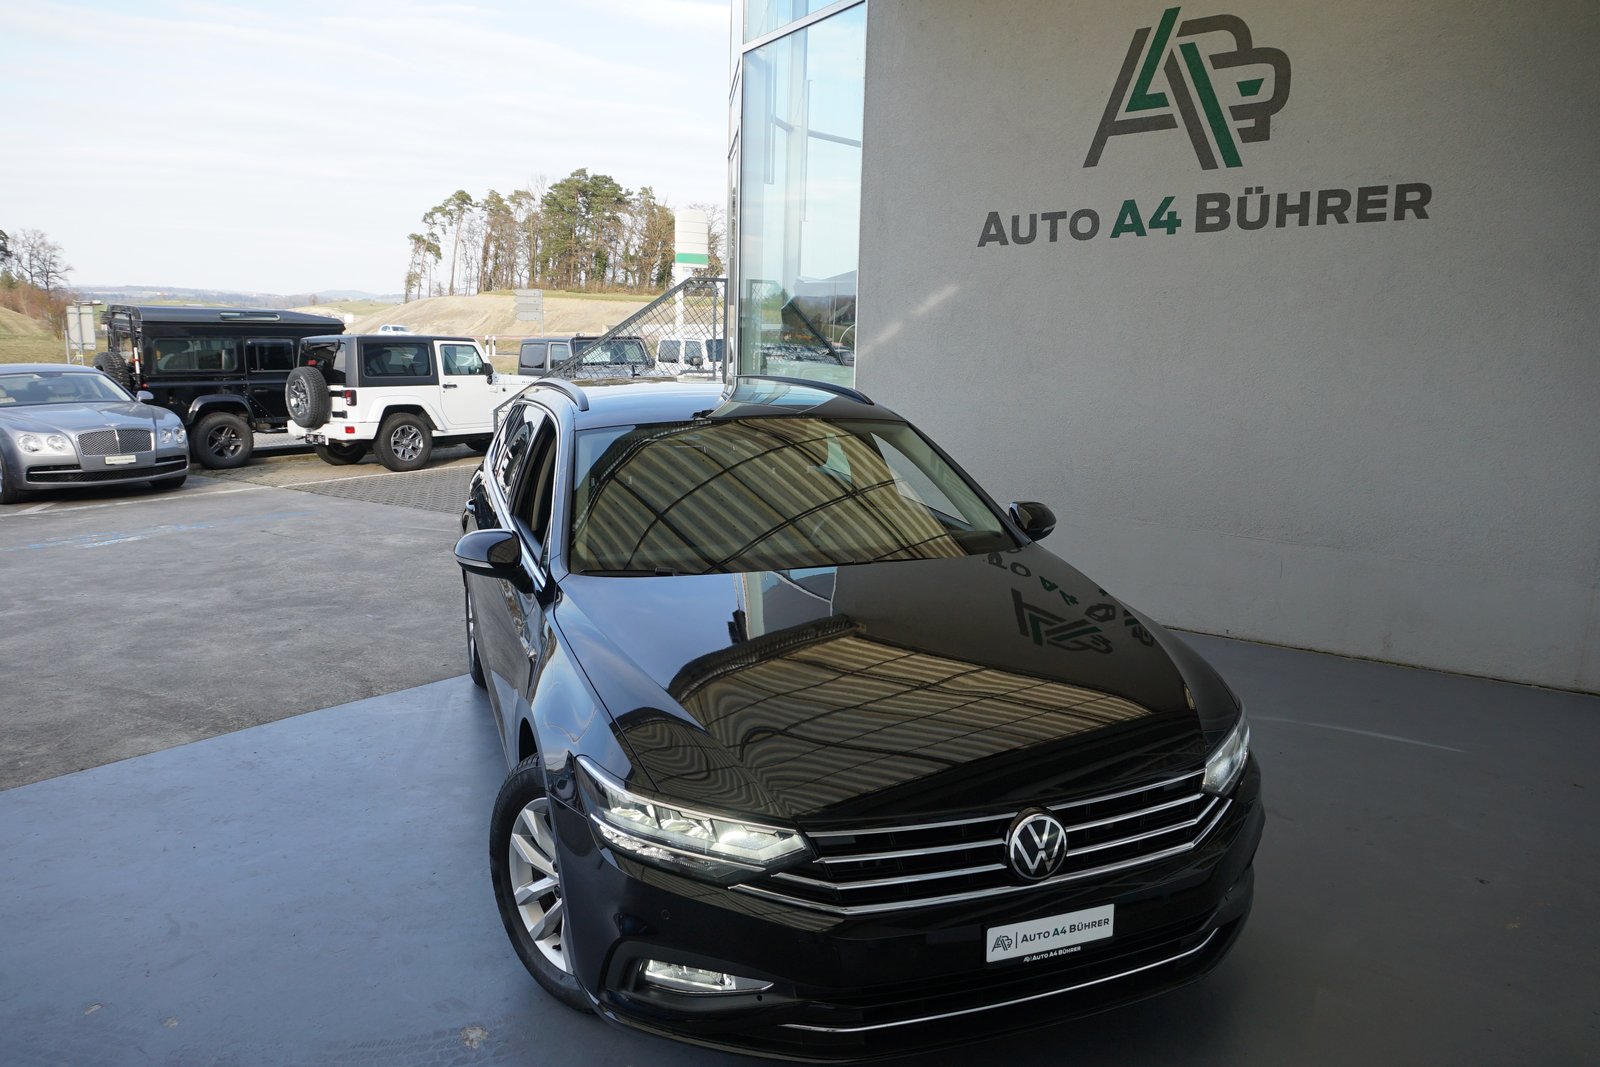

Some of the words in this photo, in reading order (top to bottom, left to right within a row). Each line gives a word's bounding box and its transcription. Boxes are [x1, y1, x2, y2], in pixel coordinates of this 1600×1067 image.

[977, 208, 1100, 248] AUTO
[1110, 196, 1182, 239] A4
[1195, 183, 1433, 234] BÜHRER
[1020, 930, 1050, 944] AUTO
[1052, 927, 1067, 938] A4
[1069, 917, 1110, 934] BÜHRER
[1032, 953, 1048, 961] AUTO
